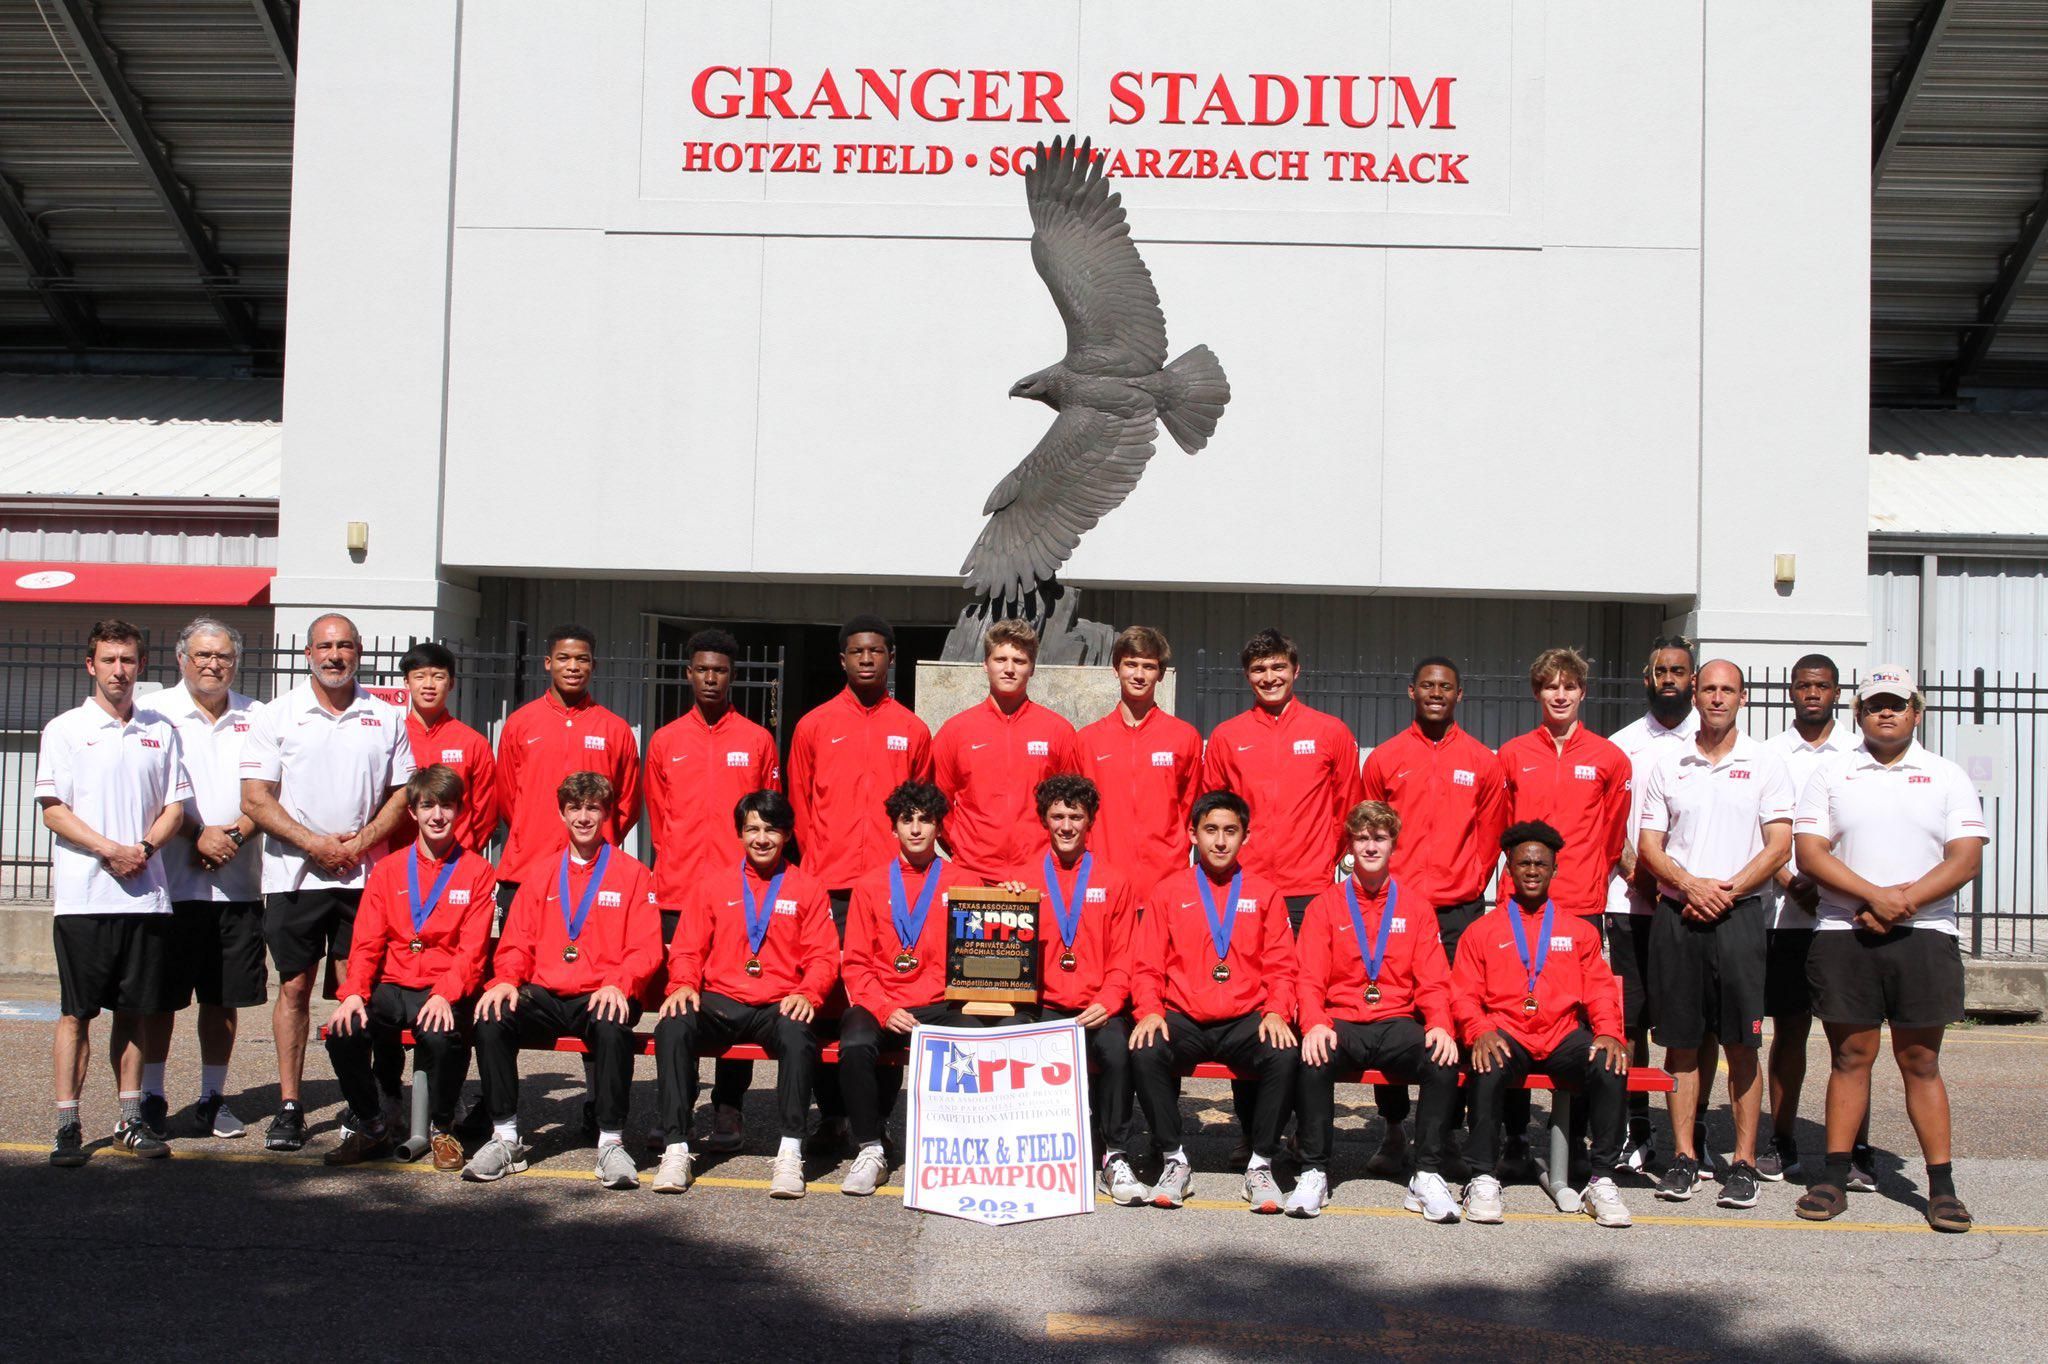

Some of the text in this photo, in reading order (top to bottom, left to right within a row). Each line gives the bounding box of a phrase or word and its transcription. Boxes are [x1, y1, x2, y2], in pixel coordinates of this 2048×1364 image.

[691, 65, 1457, 130] GRANGER STADIUM
[682, 141, 1469, 184] HOTZE FIELD SCARZBACH TRACK
[953, 911, 1034, 942] TAPPS
[952, 979, 992, 987] Competition
[925, 1035, 1072, 1093] TAPPS
[922, 1132, 1077, 1165] TRACK & FIELD
[921, 1162, 1077, 1194] CHAMPION
[958, 1197, 1035, 1214] 2021
